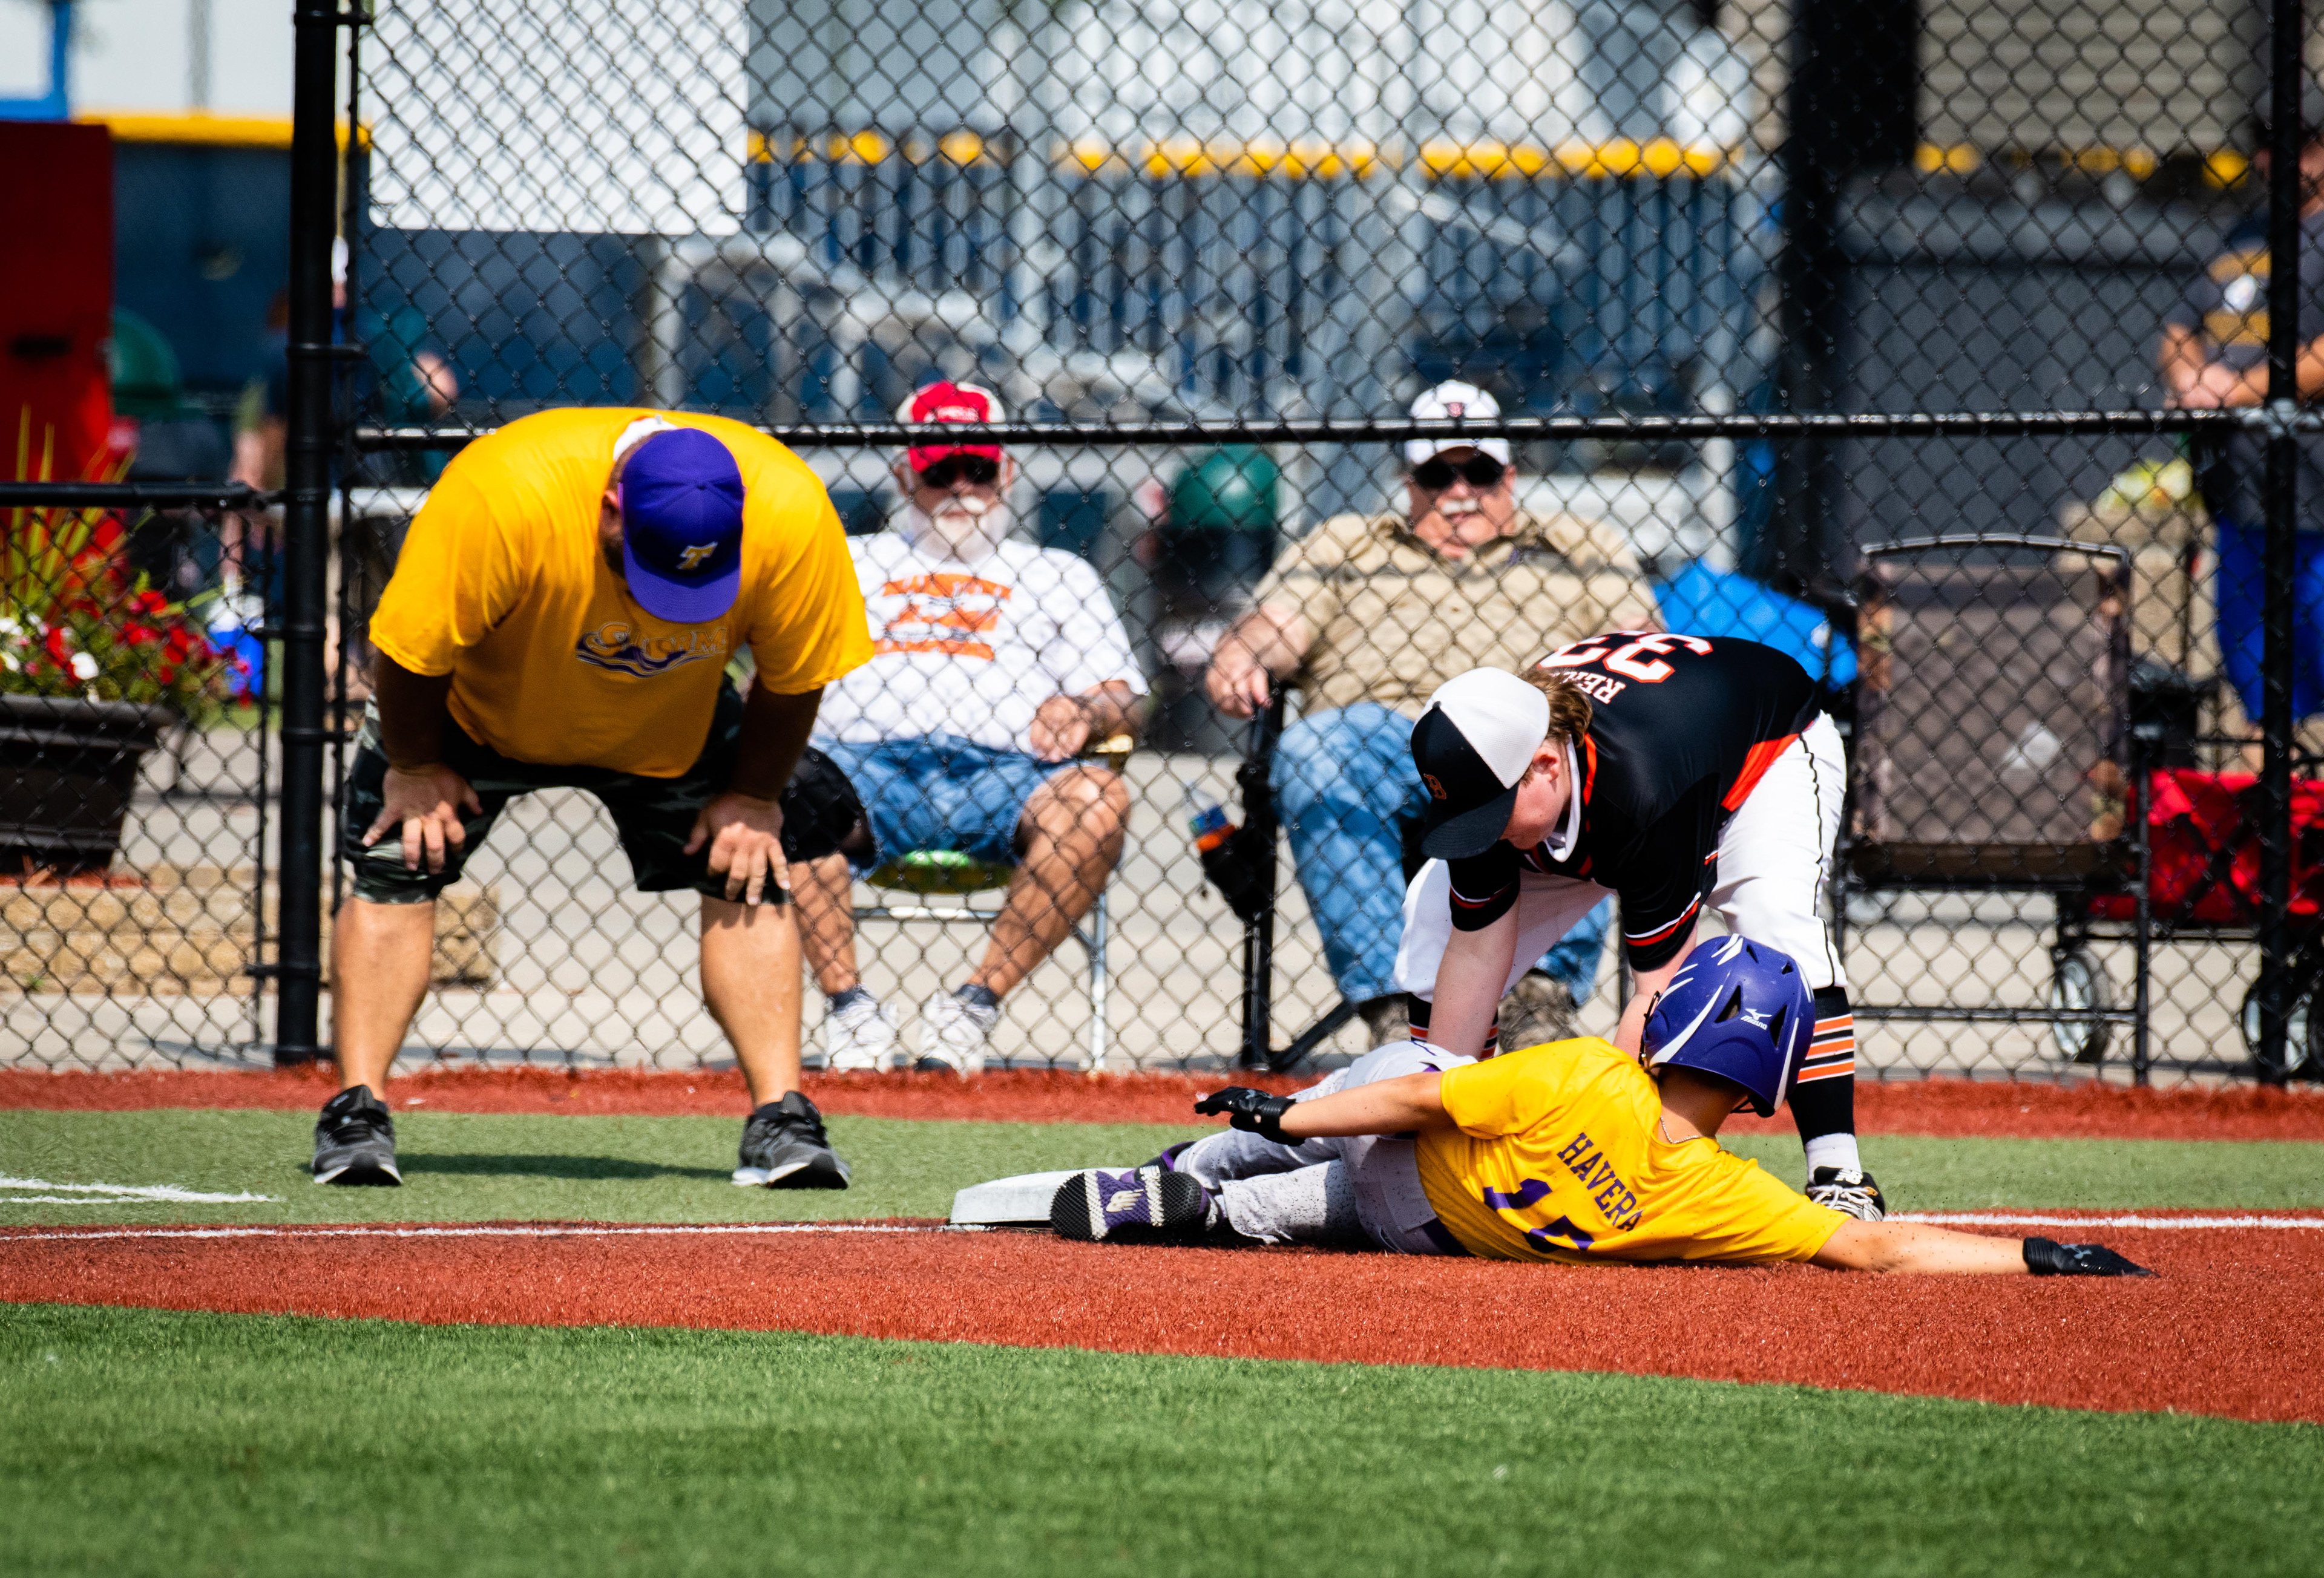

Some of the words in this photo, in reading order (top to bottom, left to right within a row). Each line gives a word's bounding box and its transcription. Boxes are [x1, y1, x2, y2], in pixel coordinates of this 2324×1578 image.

[676, 541, 718, 570] T
[1423, 773, 1446, 799] B
[1557, 1132, 1645, 1232] HAVERA
